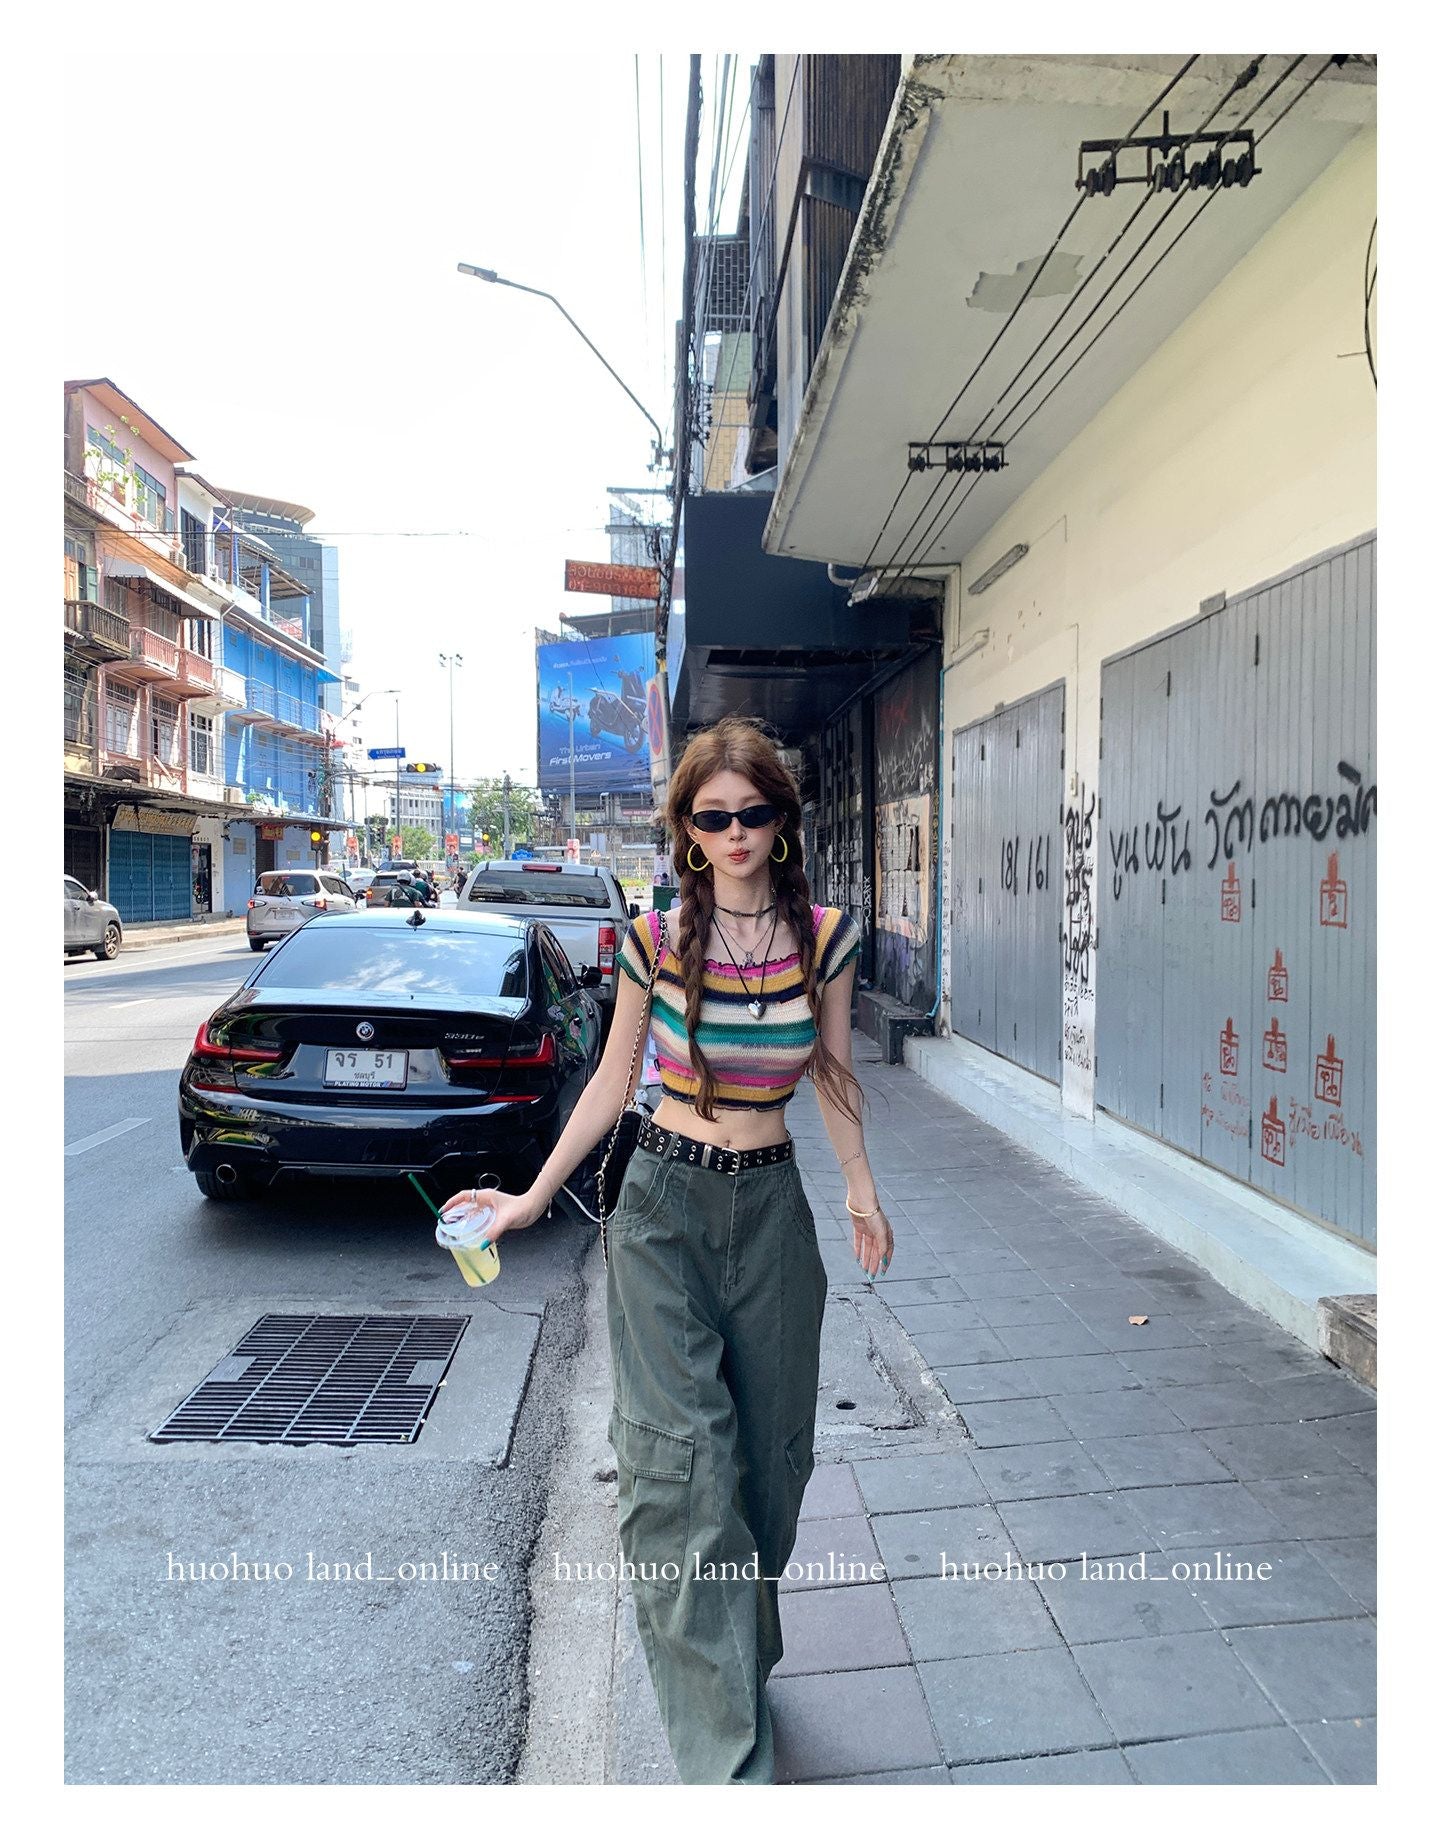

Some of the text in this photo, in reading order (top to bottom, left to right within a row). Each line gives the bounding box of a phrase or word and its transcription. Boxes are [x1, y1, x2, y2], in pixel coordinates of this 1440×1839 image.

[573, 751, 612, 763] Movers
[335, 1053, 393, 1069] จร 51
